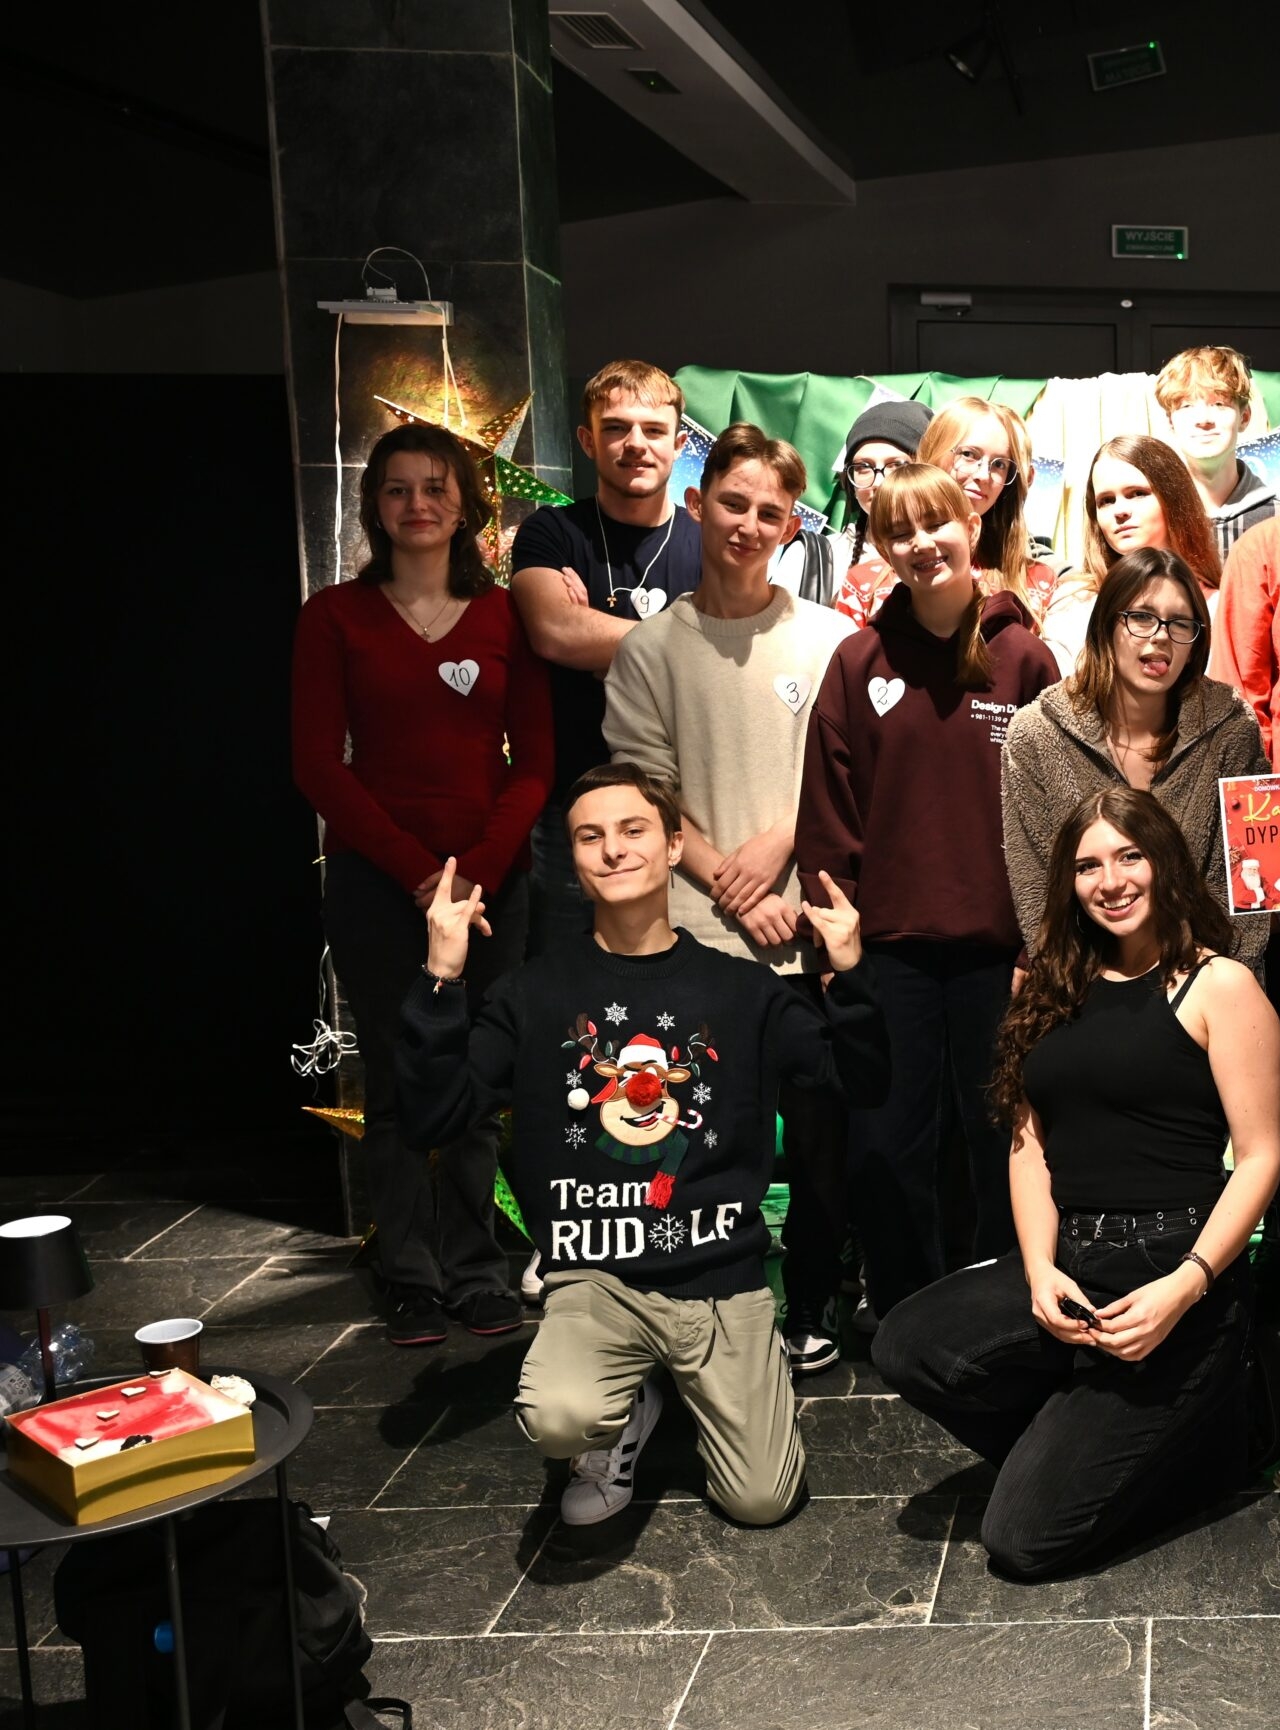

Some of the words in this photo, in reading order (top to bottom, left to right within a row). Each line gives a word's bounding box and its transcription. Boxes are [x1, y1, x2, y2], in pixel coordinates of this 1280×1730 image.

[1125, 230, 1175, 241] WYJŚCIE
[971, 699, 1006, 714] Design
[550, 1178, 653, 1210] Team
